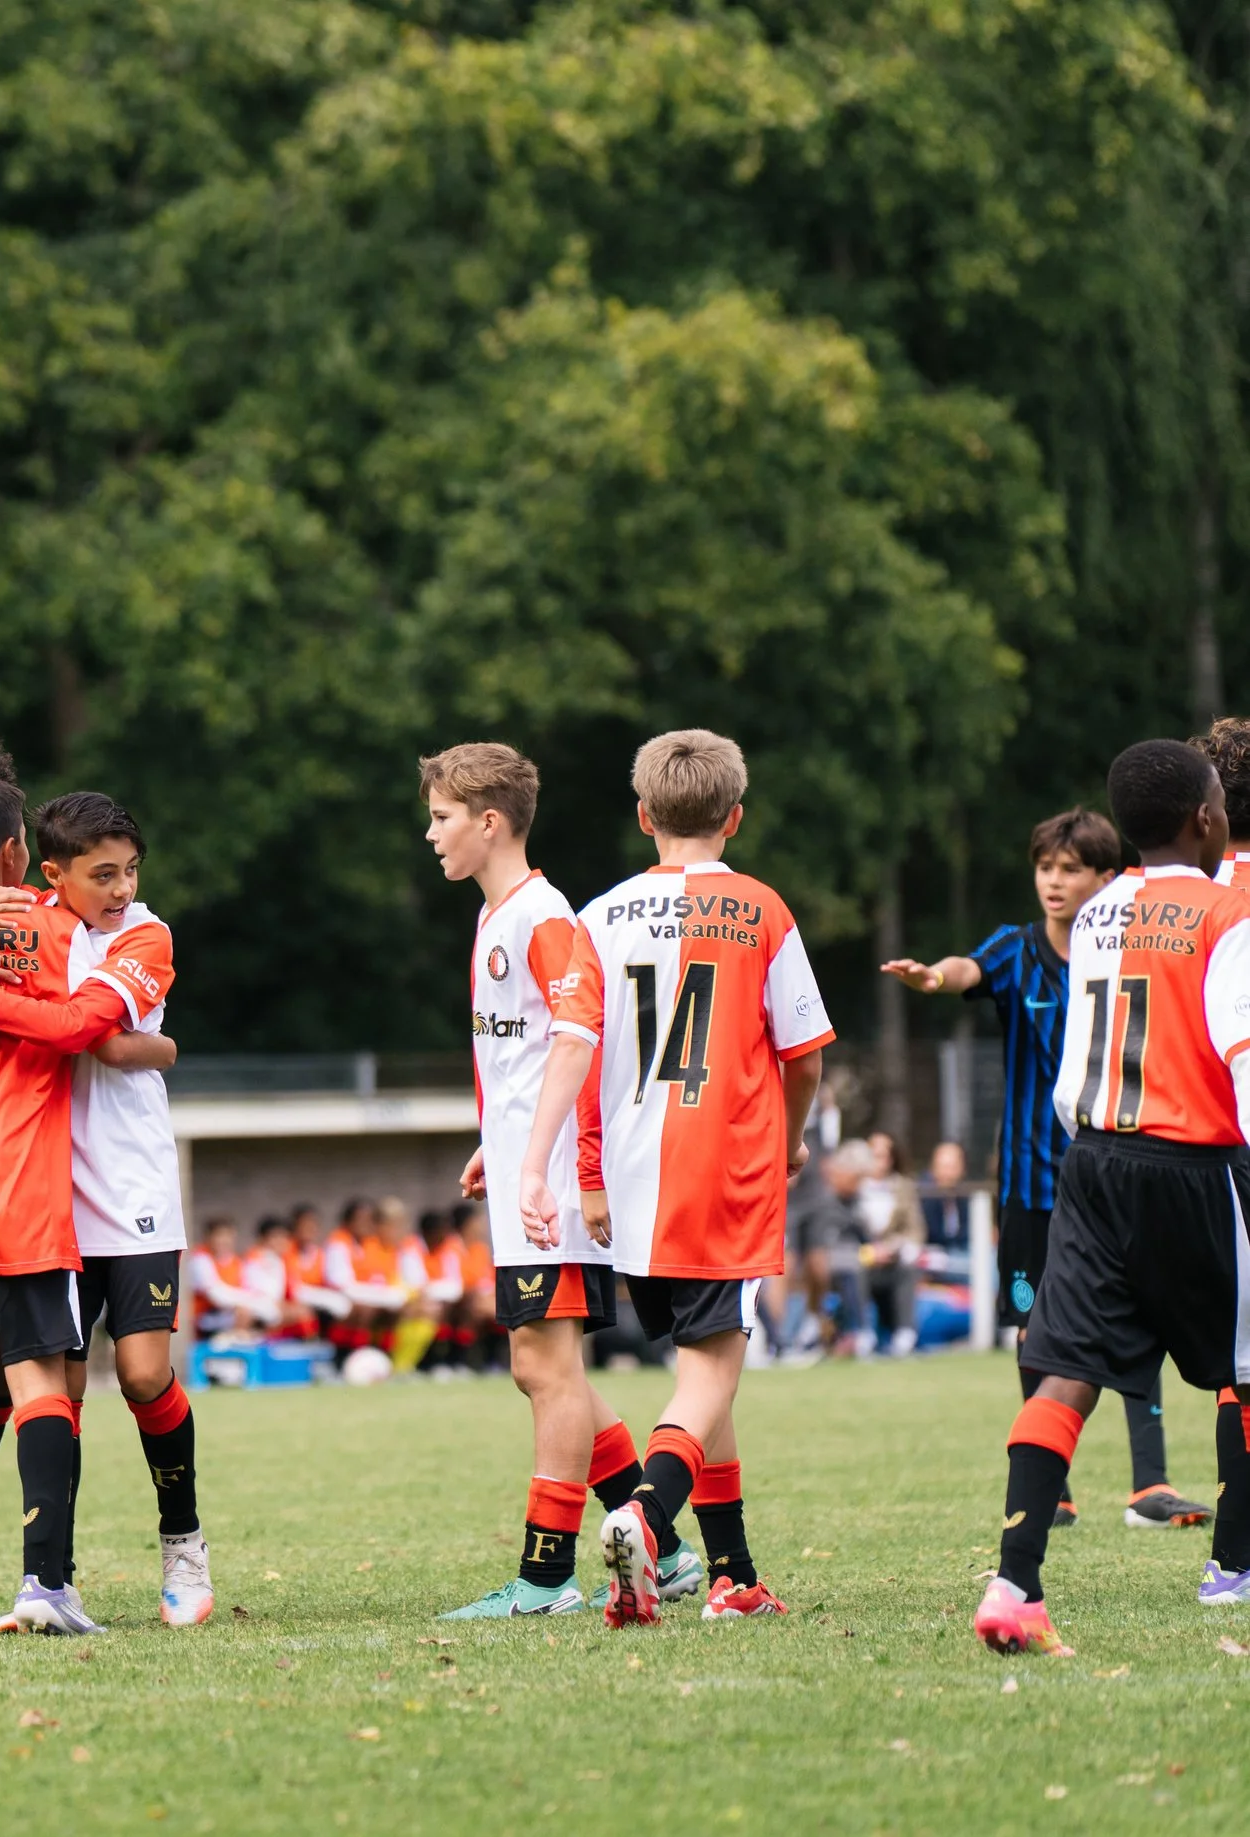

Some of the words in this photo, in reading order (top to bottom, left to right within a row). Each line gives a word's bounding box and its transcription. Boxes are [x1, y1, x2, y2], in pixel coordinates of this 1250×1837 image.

[649, 921, 759, 949] vakanties
[1095, 931, 1196, 955] vakanties
[624, 960, 718, 1108] 14
[1073, 974, 1151, 1132] 11
[153, 1464, 185, 1489] F
[526, 1531, 563, 1563] F
